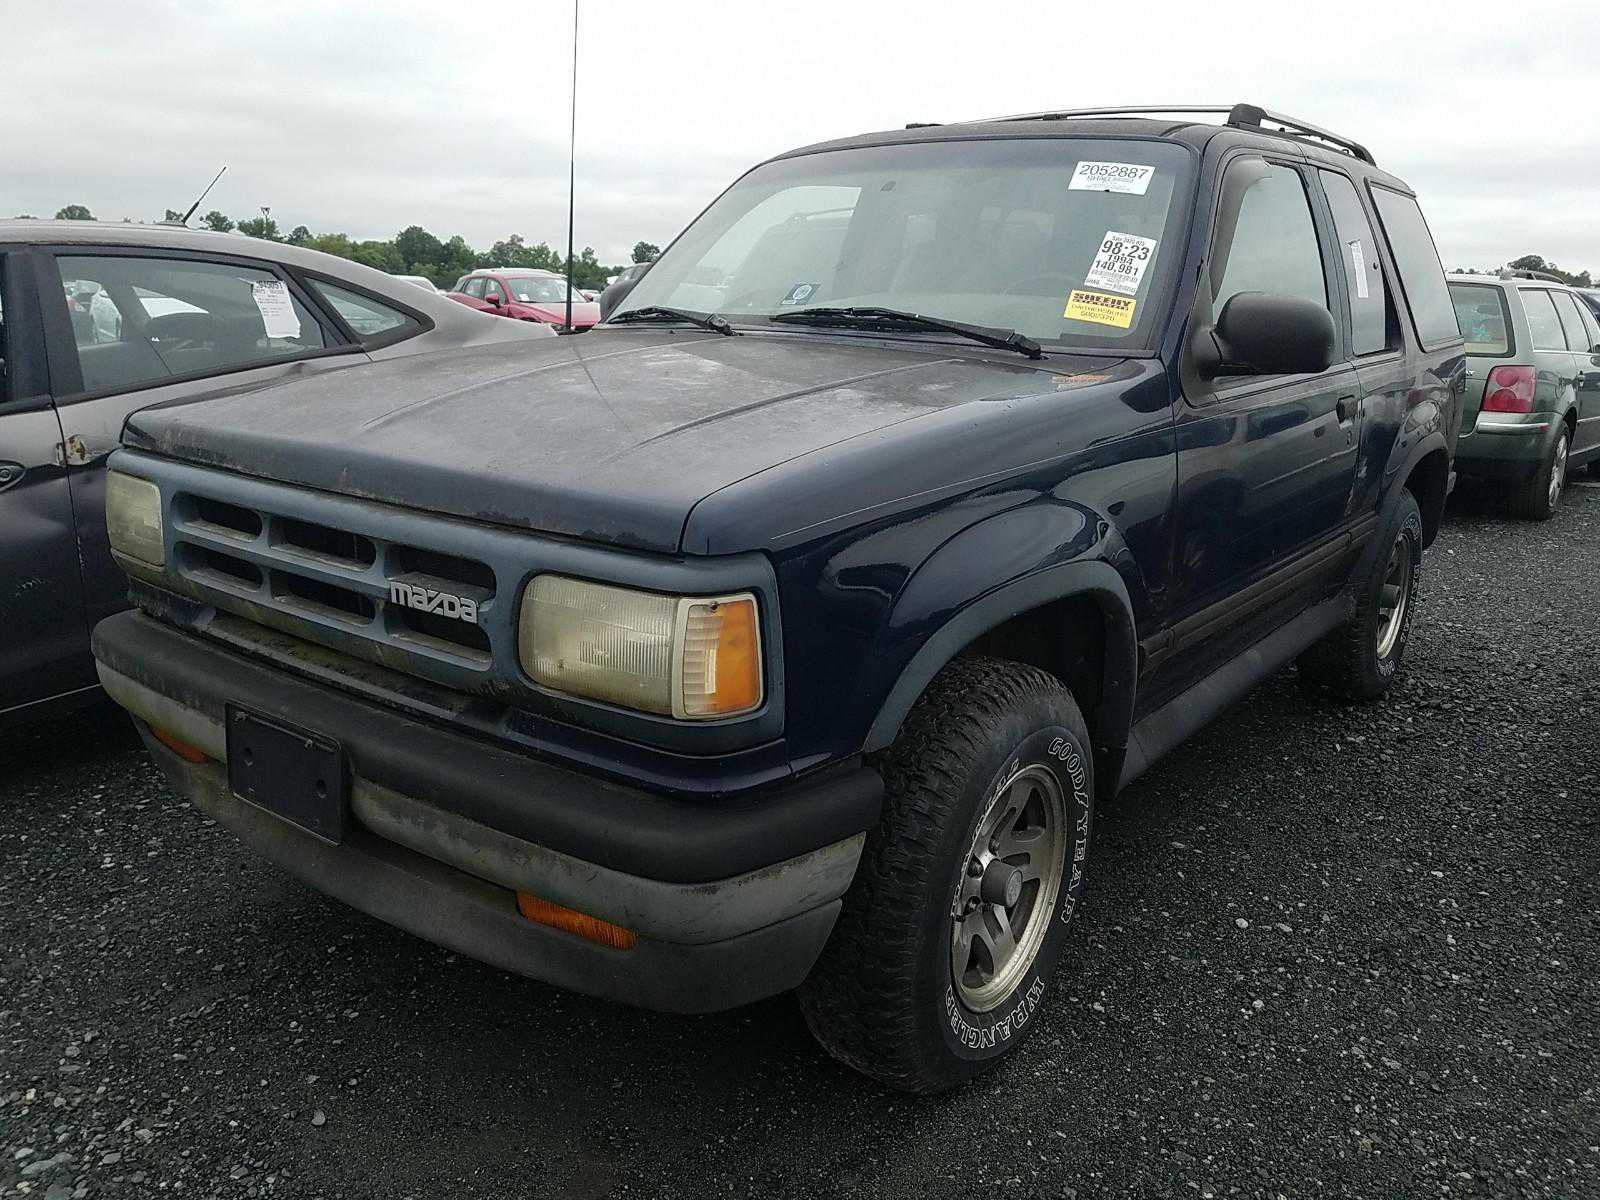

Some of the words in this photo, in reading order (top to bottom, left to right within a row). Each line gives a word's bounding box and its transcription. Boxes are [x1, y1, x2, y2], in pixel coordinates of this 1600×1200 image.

[1079, 164, 1149, 179] 2052887
[1101, 239, 1150, 261] 98:23
[1107, 254, 1134, 266] 1994
[1047, 736, 1090, 924] GOODYEAR
[945, 976, 1045, 1049] WRANGLER
